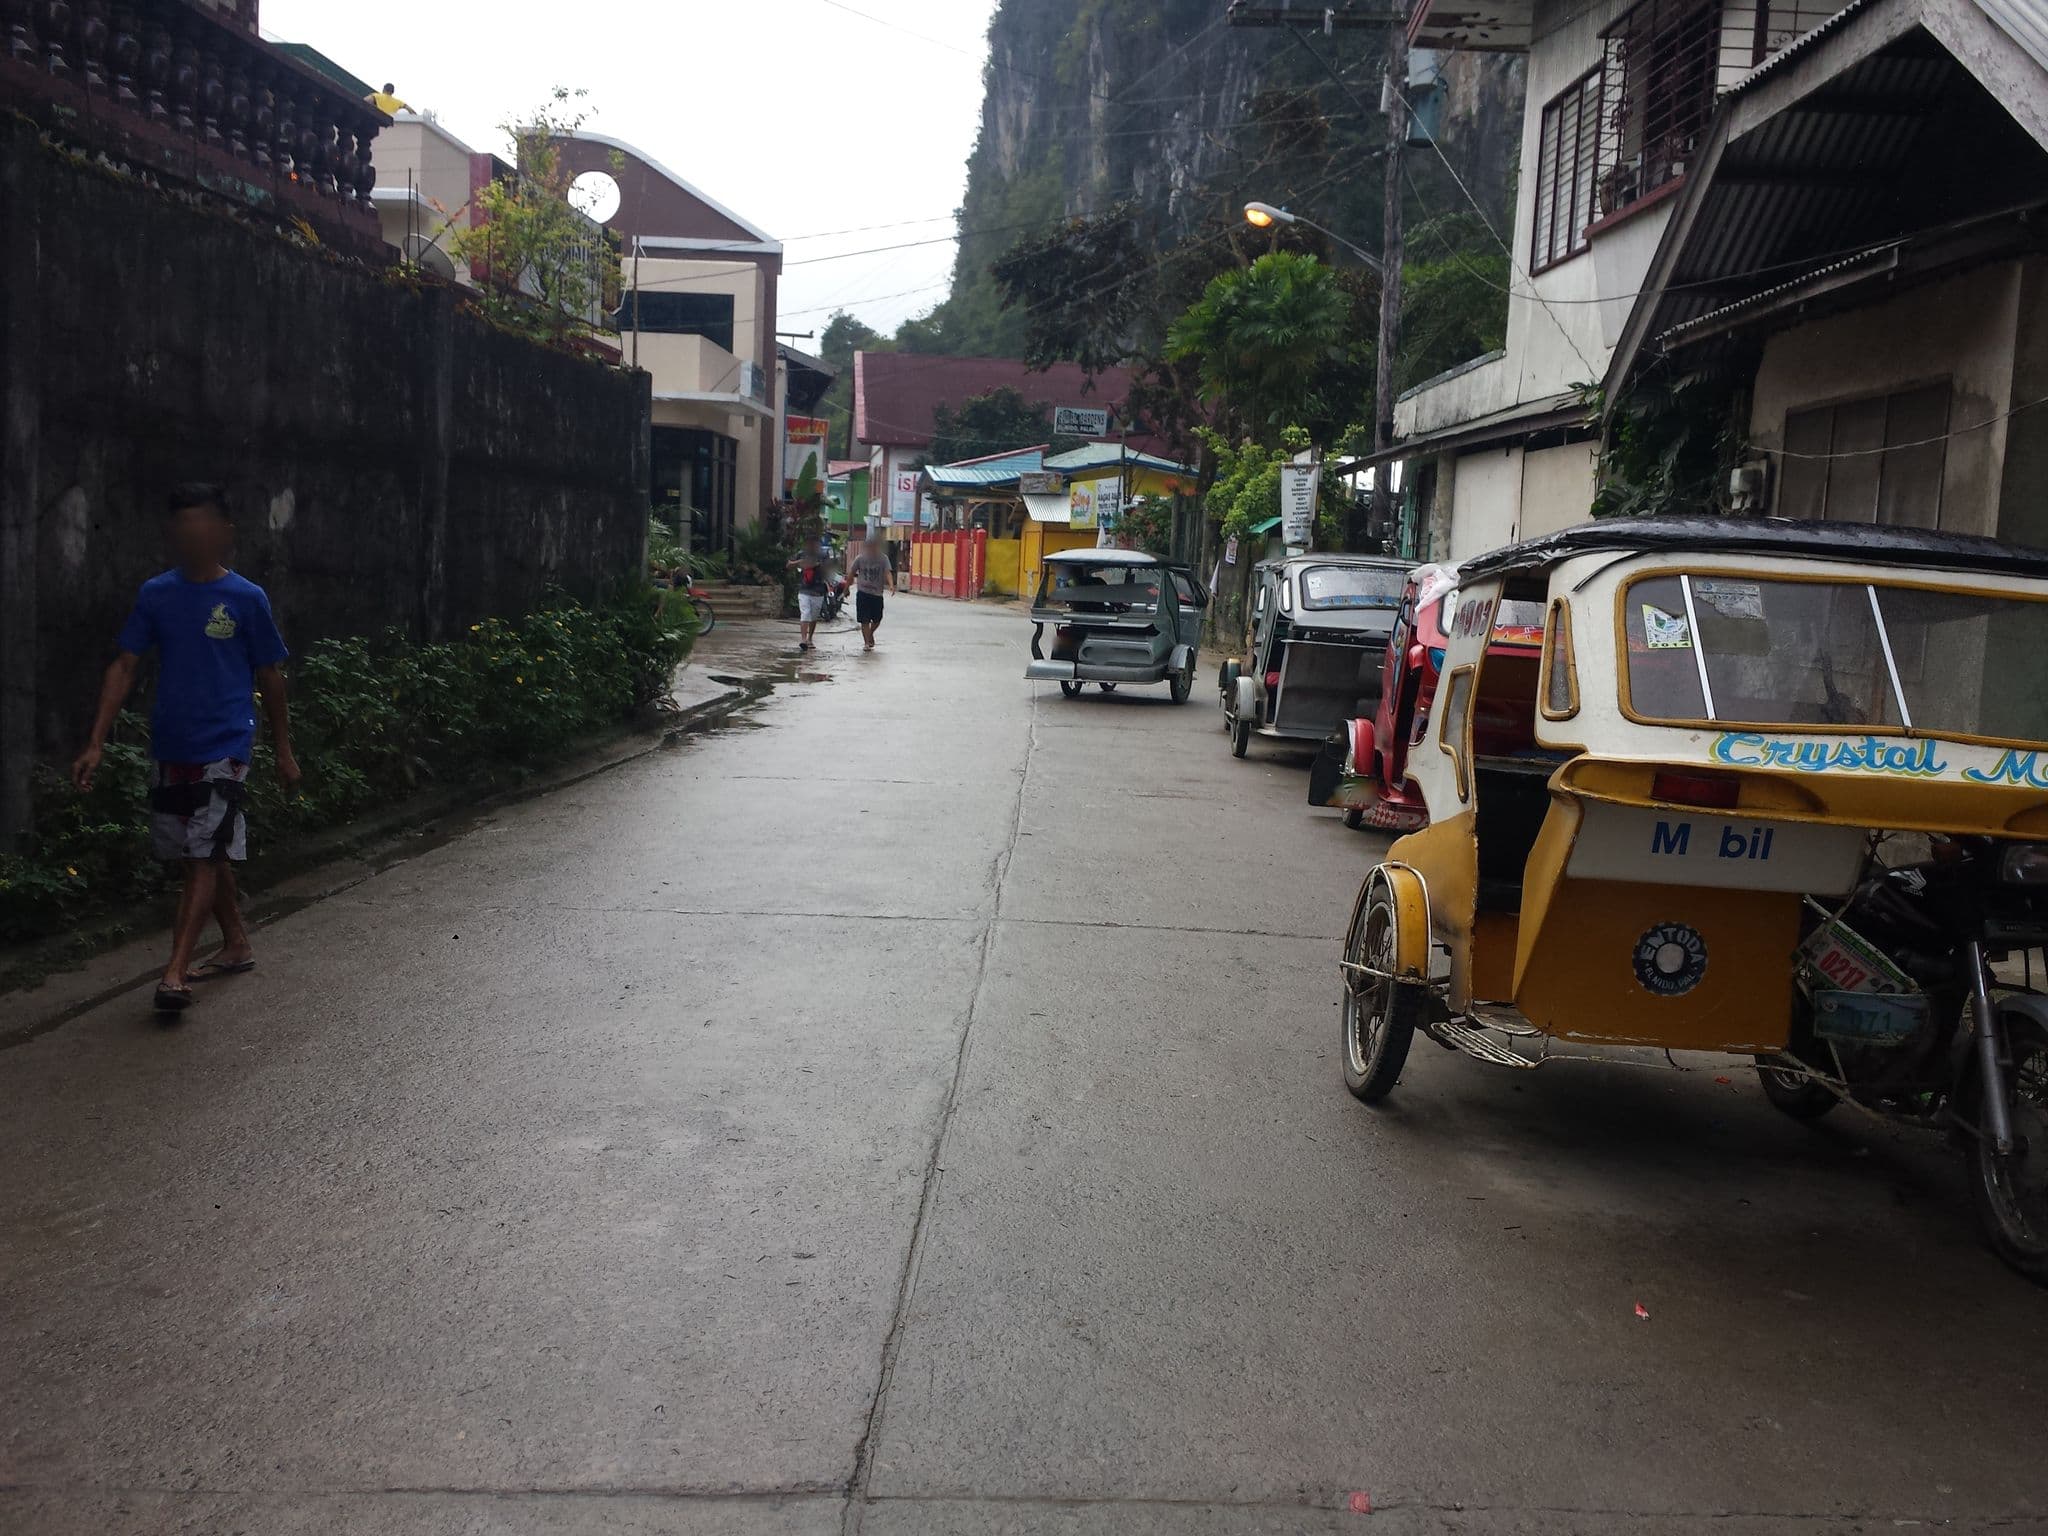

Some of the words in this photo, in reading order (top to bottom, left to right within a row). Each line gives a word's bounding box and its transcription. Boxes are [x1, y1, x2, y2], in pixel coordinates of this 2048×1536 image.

[1709, 732, 1948, 777] Crystal
[1961, 748, 2048, 790] M
[1639, 927, 1706, 963] ENTODA
[1818, 949, 1868, 991] 0217
